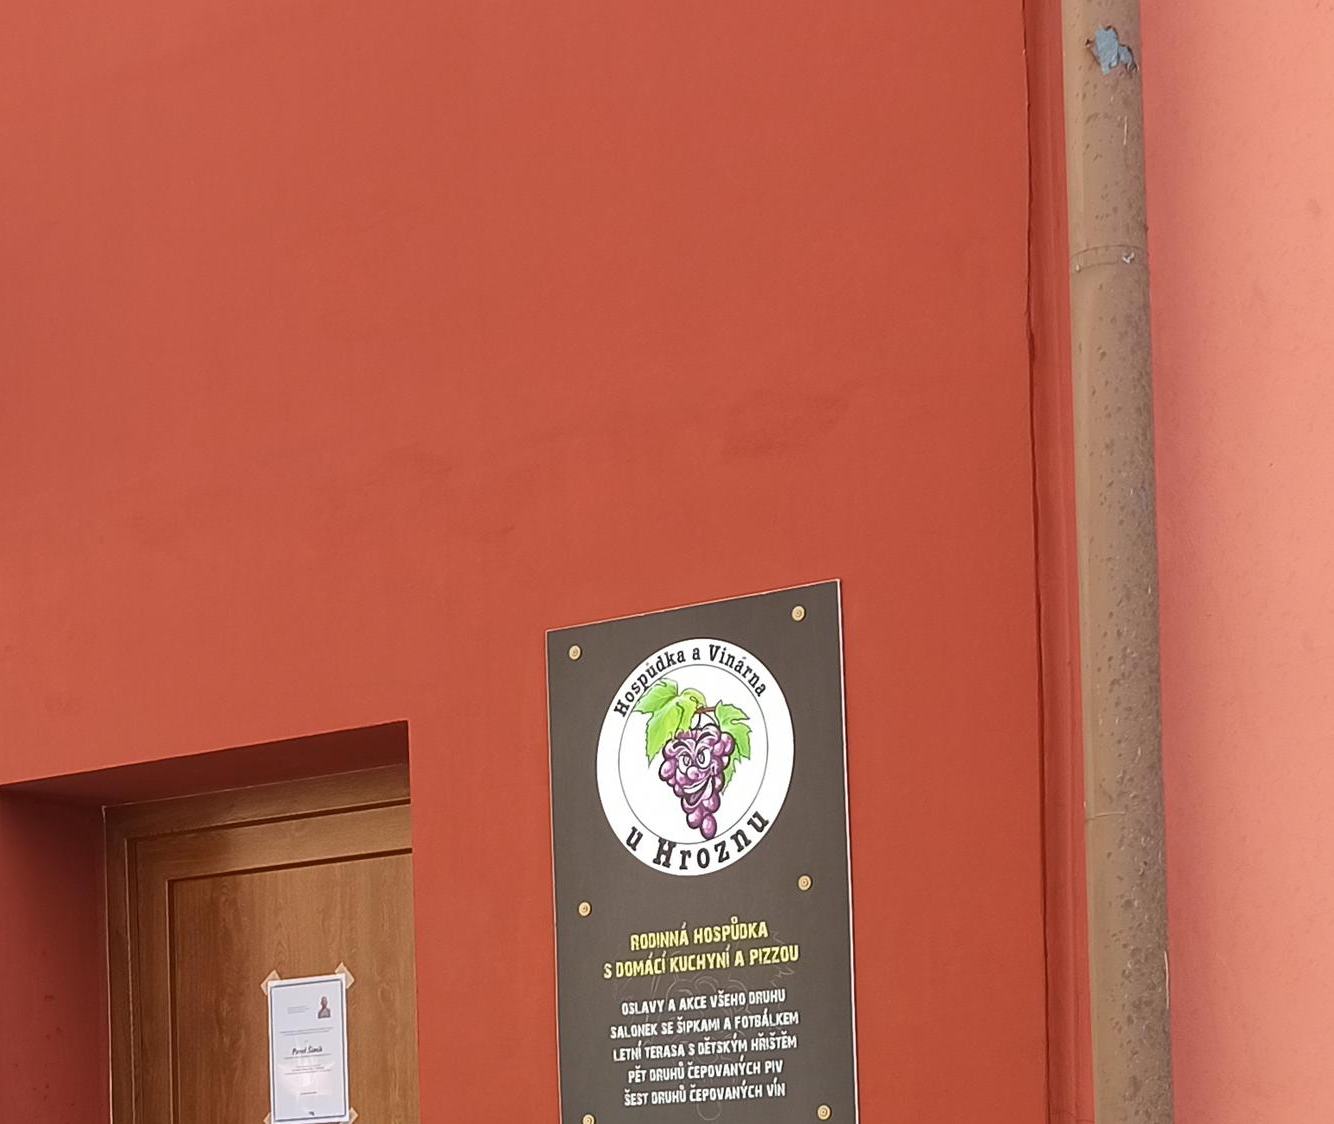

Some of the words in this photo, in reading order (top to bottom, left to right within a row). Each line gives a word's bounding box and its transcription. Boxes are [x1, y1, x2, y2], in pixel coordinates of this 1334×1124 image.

[692, 647, 701, 660] a
[709, 644, 767, 697] Vinárna
[626, 826, 644, 851] u
[653, 811, 769, 870] Hroznu
[630, 921, 689, 951] RODINNÁ
[694, 916, 769, 944] HOSPŮDKA
[603, 962, 613, 979] S
[616, 951, 666, 978] DOMÁCÍ
[669, 944, 730, 973] KUCHYNÍ
[734, 950, 745, 968] A
[749, 944, 799, 966] PIZZOU
[621, 999, 665, 1016] OSLAVY
[668, 998, 676, 1012] A
[679, 995, 707, 1011] AKCE
[710, 990, 746, 1008] VŠEHO
[748, 988, 786, 1006] DRUHU
[610, 1023, 658, 1039] SALONEK
[661, 1021, 674, 1035] SE
[676, 1016, 721, 1034] ŠIPKAMI
[723, 1016, 732, 1030] A
[735, 1008, 799, 1029] FOTBÁLKEM
[613, 1040, 642, 1061] LETNÍ
[644, 1046, 685, 1060] TERASA
[688, 1044, 696, 1056] S
[698, 1033, 748, 1055] DĚTSKÝM
[751, 1030, 797, 1051] HŘIŠTĚM
[628, 1065, 647, 1084] PĚT
[649, 1061, 685, 1081] DRUHŮ
[687, 1055, 761, 1079] ČEPOVANÝCH
[764, 1060, 784, 1074] PIV
[624, 1089, 649, 1106] ŠEST
[651, 1084, 687, 1105] DRUHŮ
[689, 1080, 763, 1102] ČEPOVANÝCH
[766, 1077, 786, 1097] VÍN
